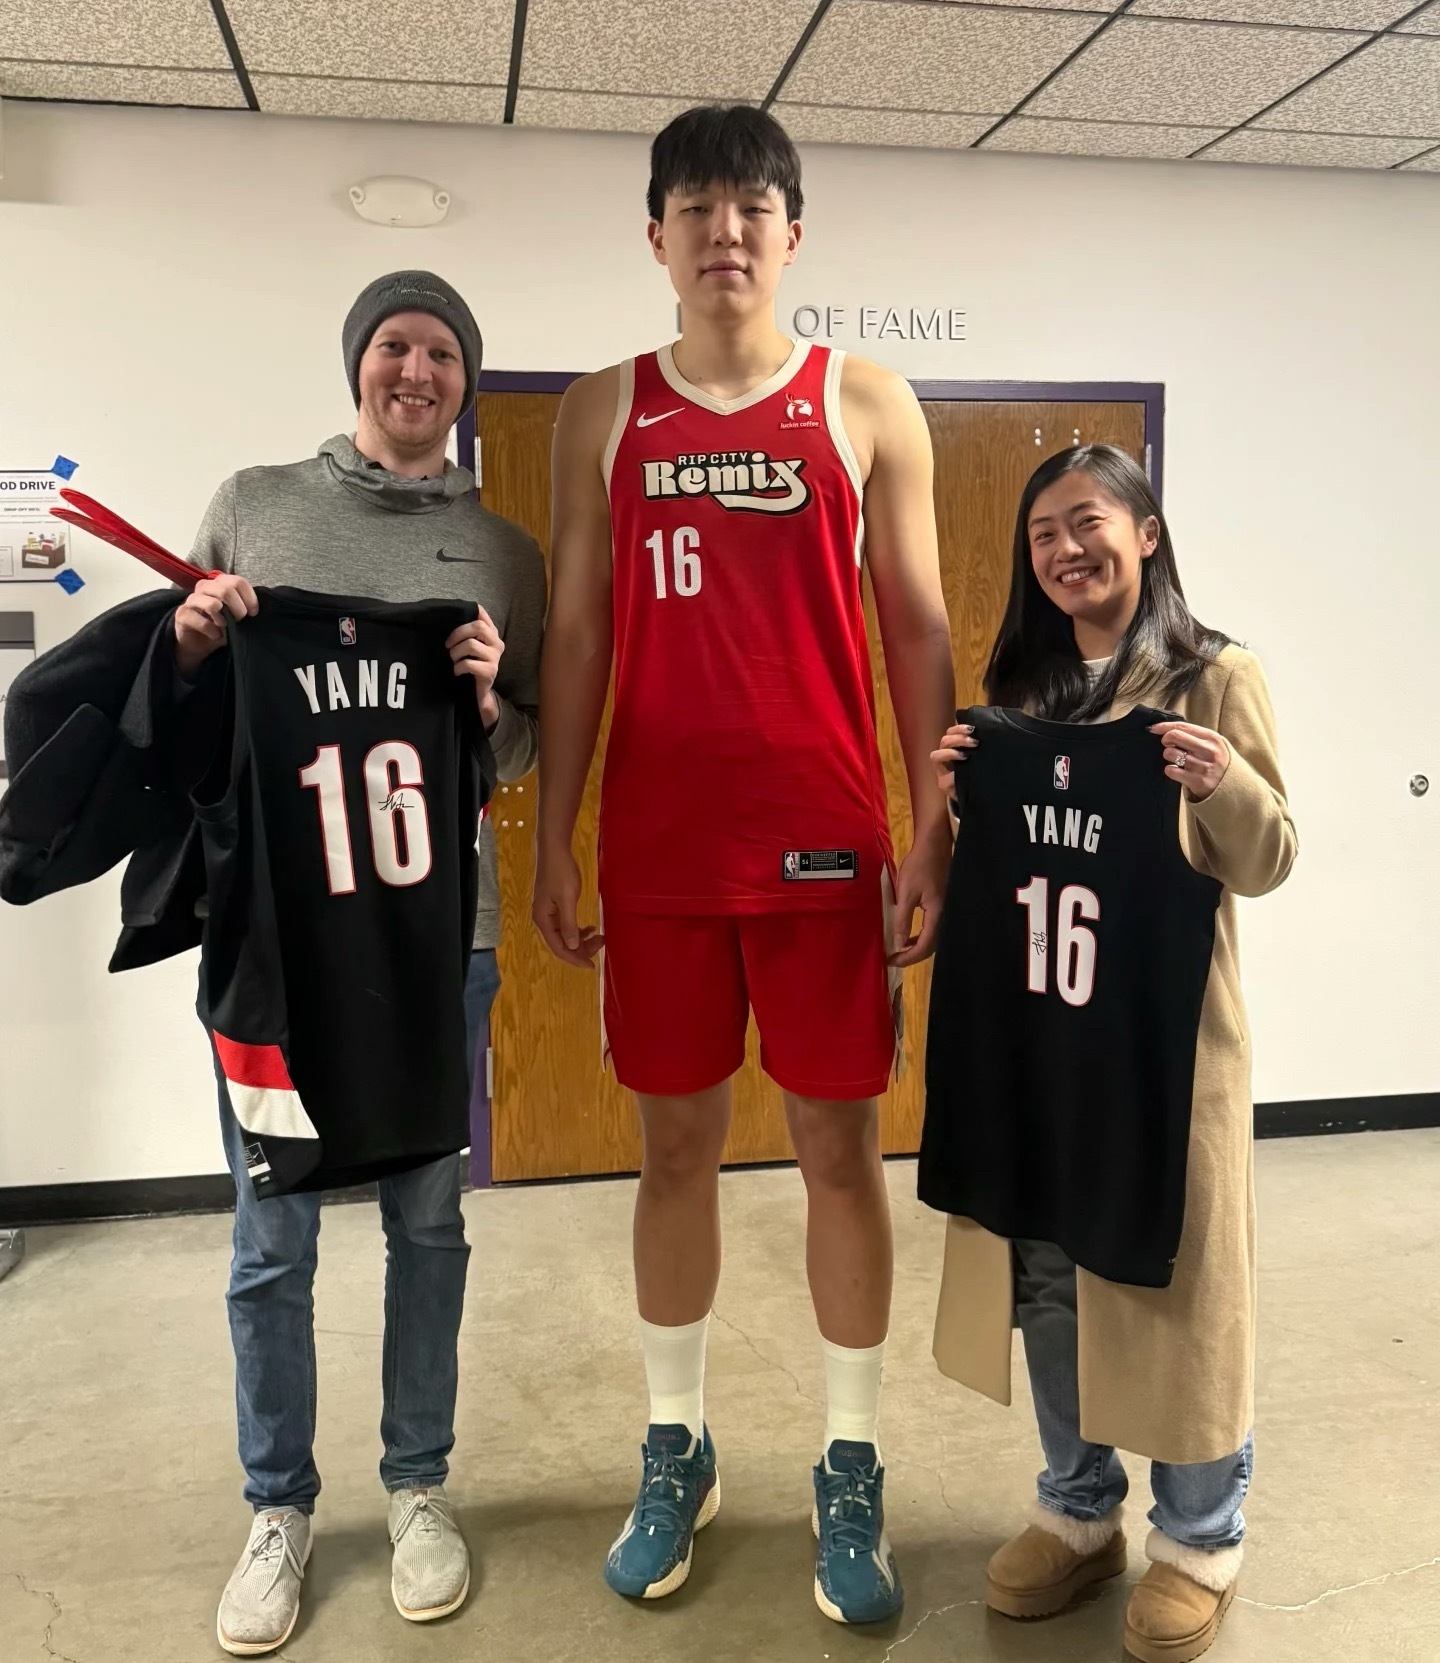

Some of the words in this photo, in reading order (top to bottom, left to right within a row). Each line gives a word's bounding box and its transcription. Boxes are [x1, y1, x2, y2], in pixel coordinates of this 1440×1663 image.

[793, 304, 845, 338] OF
[860, 307, 967, 341] FAME
[20, 481, 56, 490] DRIVE
[641, 451, 810, 513] Remix
[678, 454, 707, 466] RIP
[710, 452, 748, 464] CITY
[645, 525, 702, 600] 16
[293, 659, 408, 714] YANG
[298, 739, 433, 896] 16
[1022, 804, 1103, 854] YANG
[1016, 875, 1100, 1007] 16
